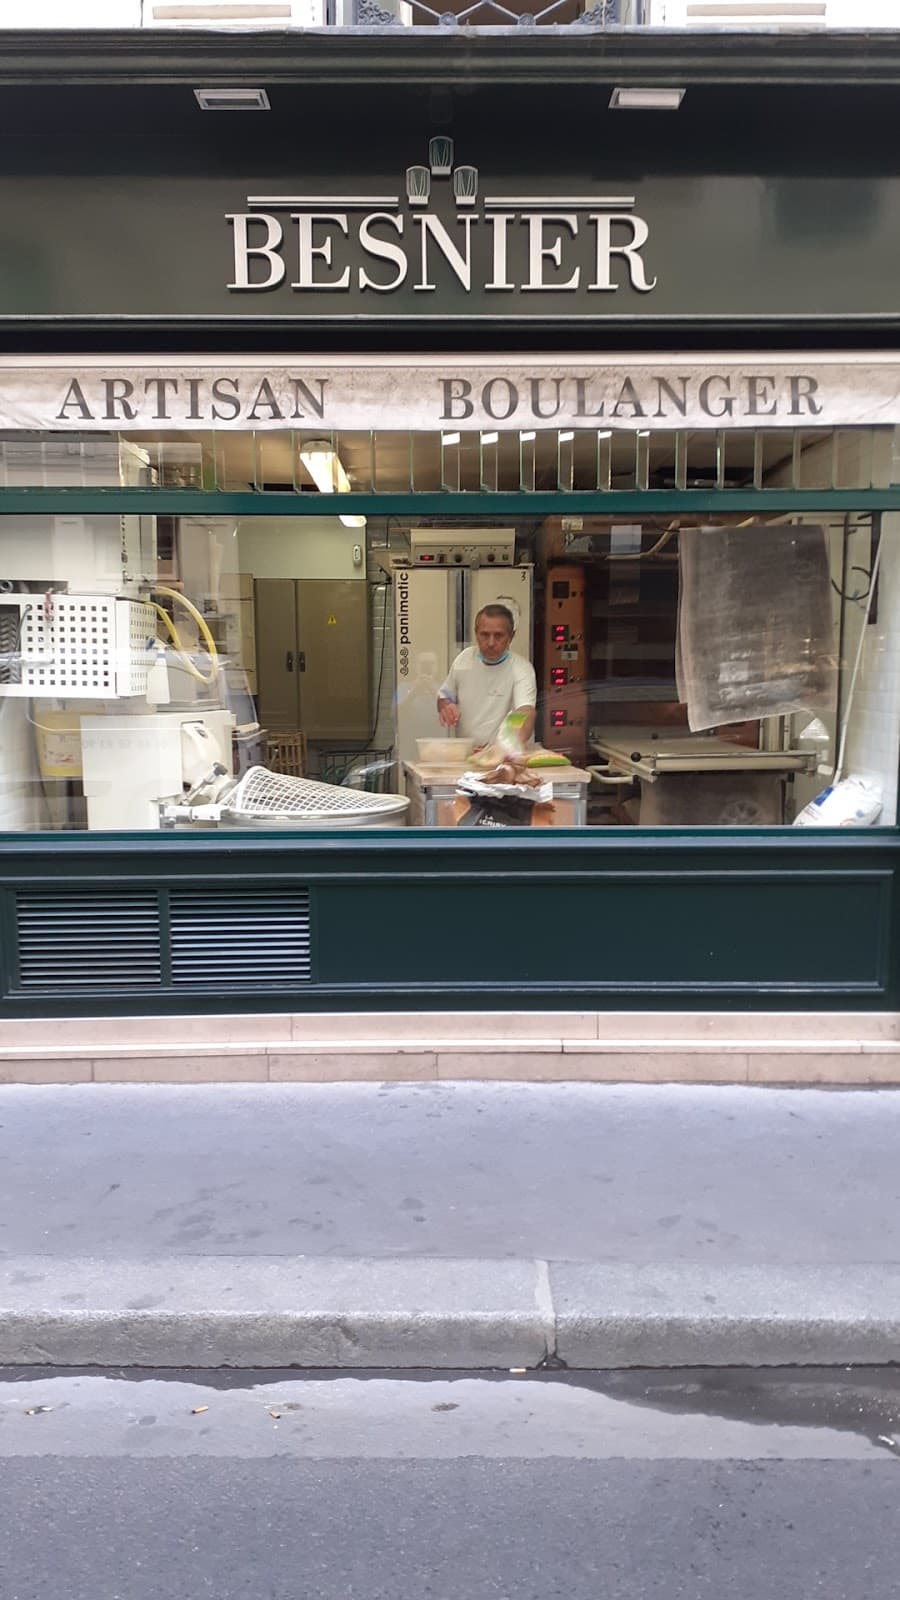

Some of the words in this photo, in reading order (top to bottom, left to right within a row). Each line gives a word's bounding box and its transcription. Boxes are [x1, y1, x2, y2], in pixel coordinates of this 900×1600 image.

[225, 212, 657, 292] BESNIER
[55, 377, 329, 421] ARTISAN
[438, 374, 823, 421] BOULANGER
[397, 571, 411, 645] panimatic
